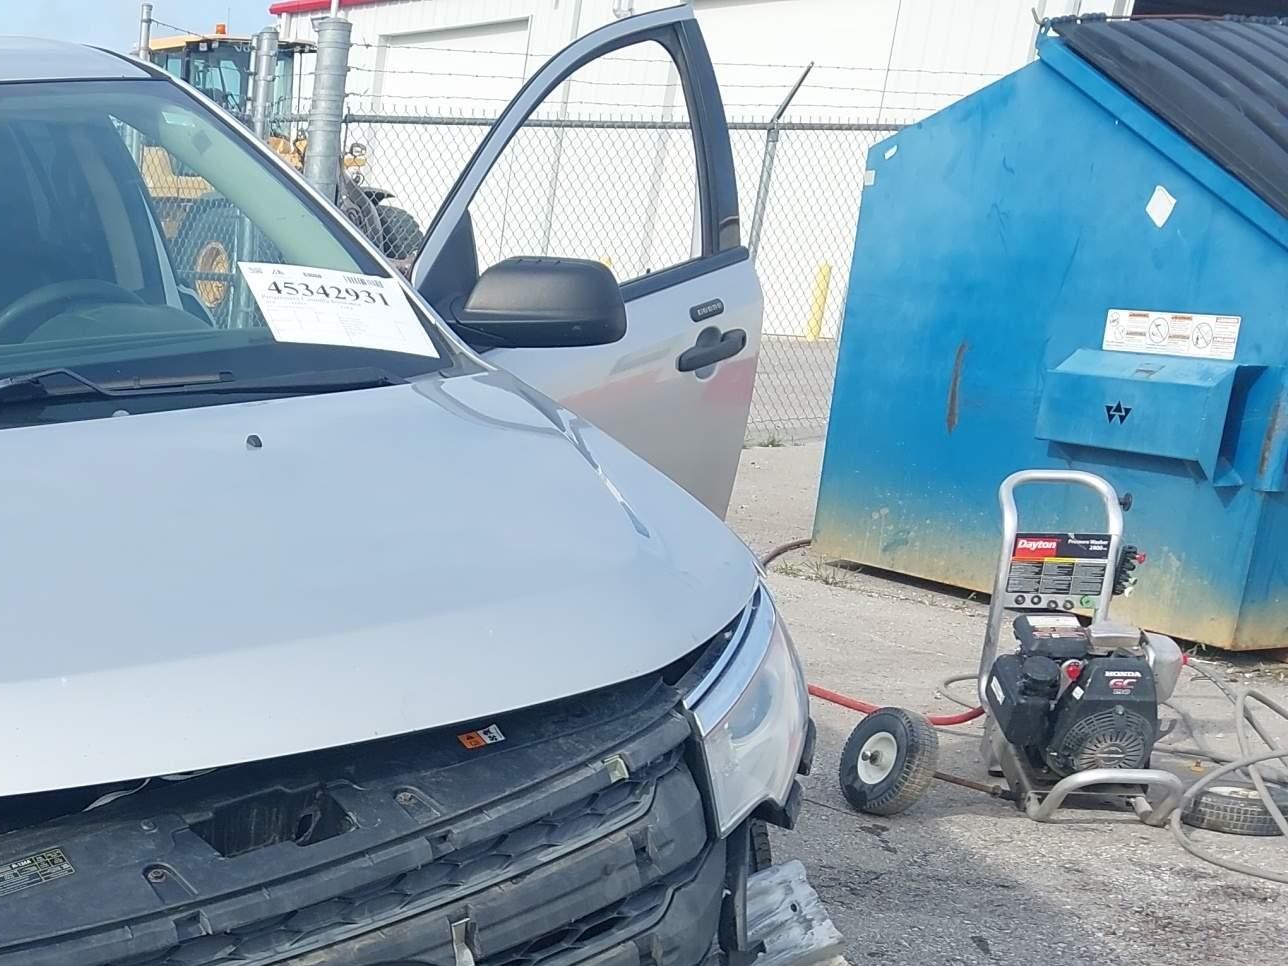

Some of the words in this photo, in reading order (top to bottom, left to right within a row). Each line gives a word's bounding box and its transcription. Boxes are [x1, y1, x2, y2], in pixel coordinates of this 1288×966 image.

[267, 280, 390, 306] 45342931
[1017, 539, 1057, 551] Dayton
[1109, 678, 1137, 689] GC
